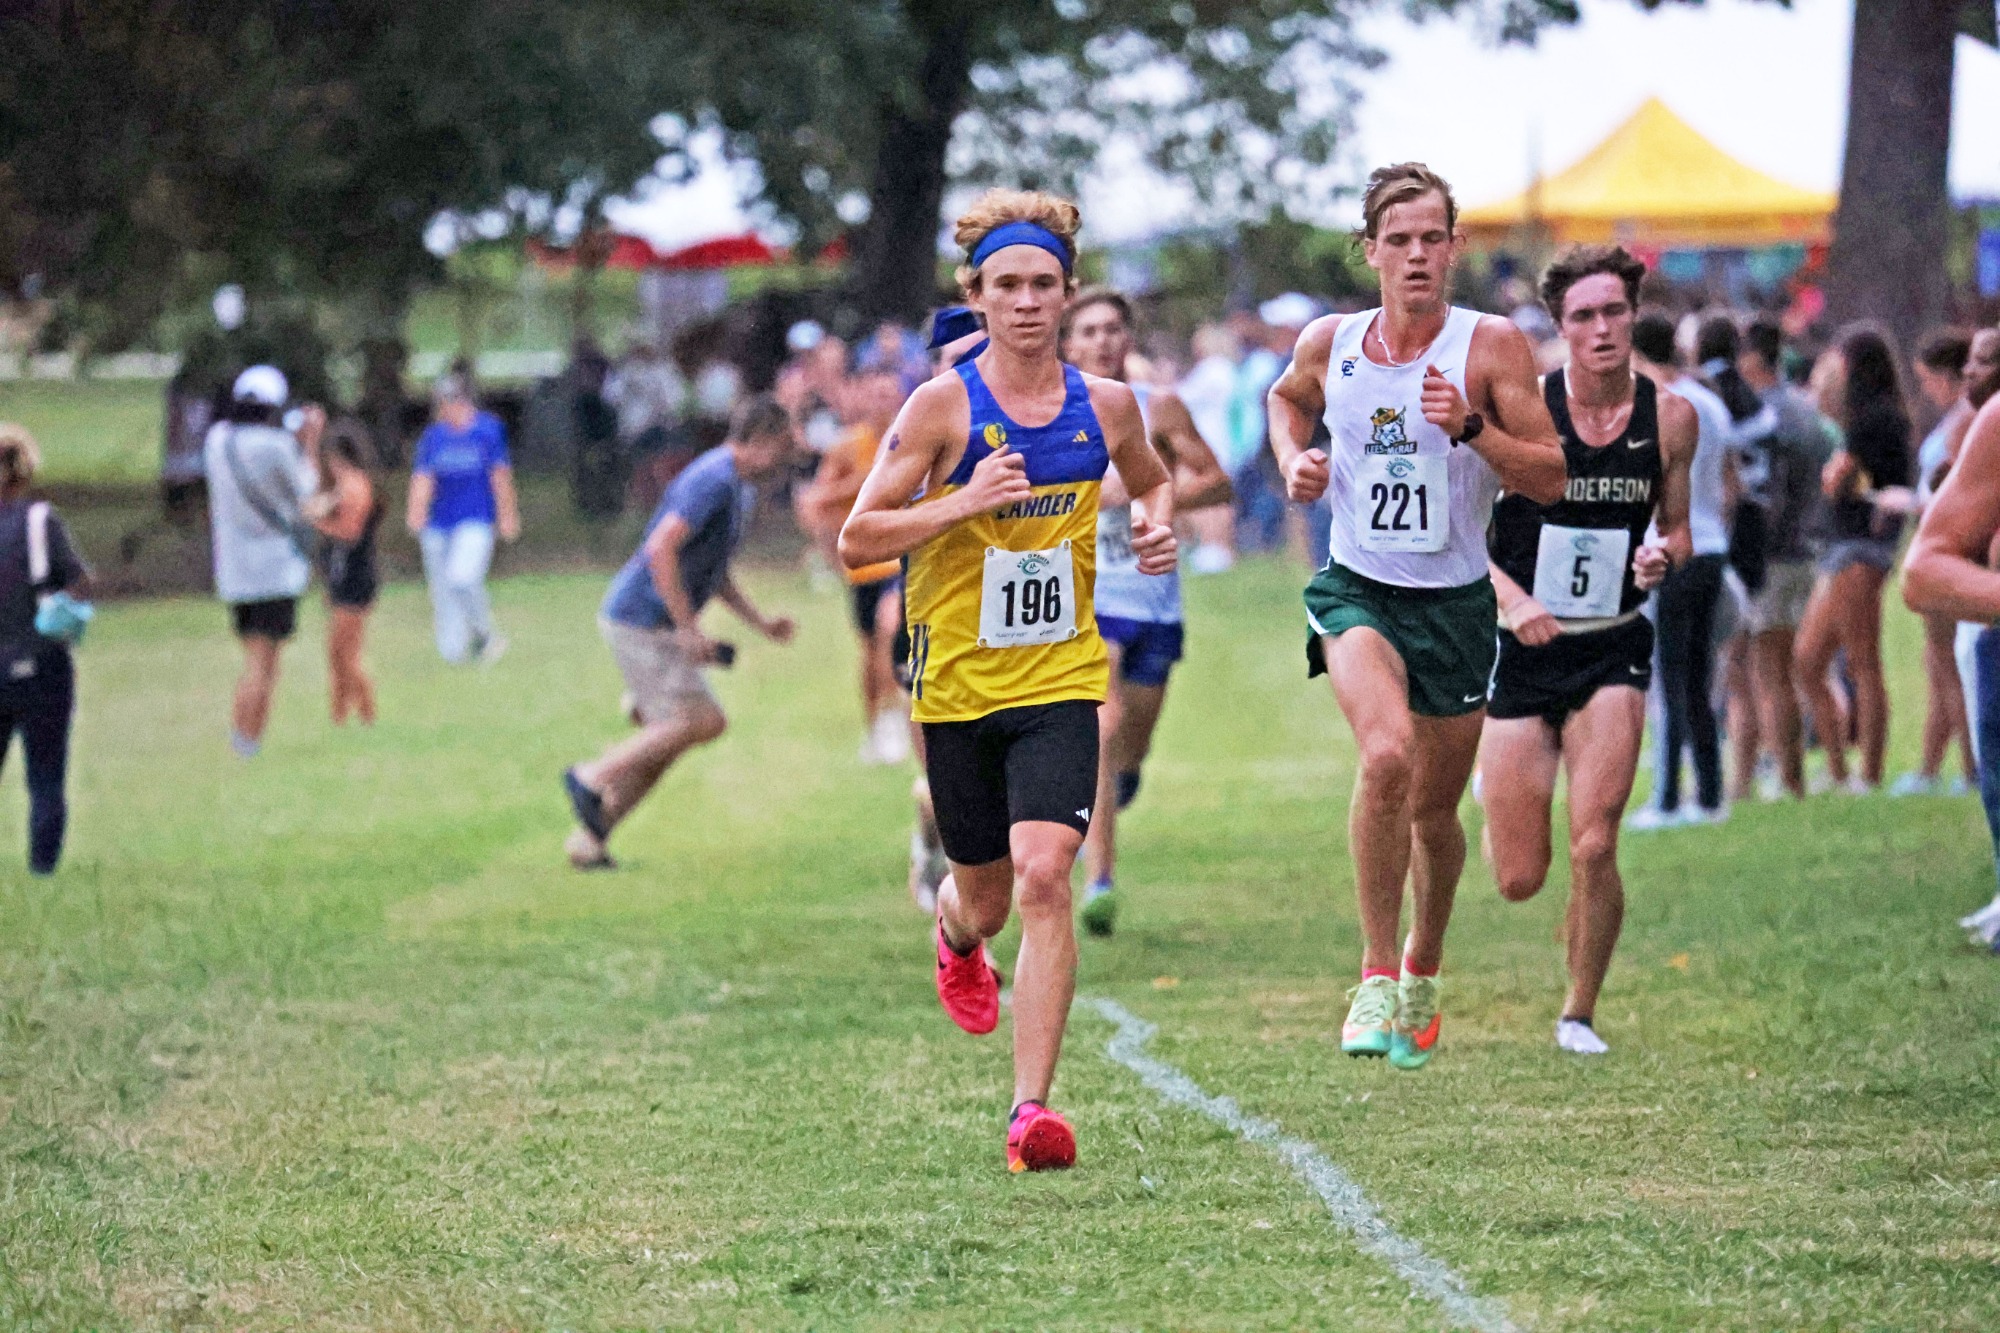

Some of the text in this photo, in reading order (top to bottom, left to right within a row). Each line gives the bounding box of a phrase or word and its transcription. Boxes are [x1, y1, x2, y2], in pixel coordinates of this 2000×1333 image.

[1371, 483, 1428, 530] 221
[1564, 477, 1651, 502] NDERSON
[1571, 555, 1591, 598] 5
[1001, 576, 1061, 627] 196
